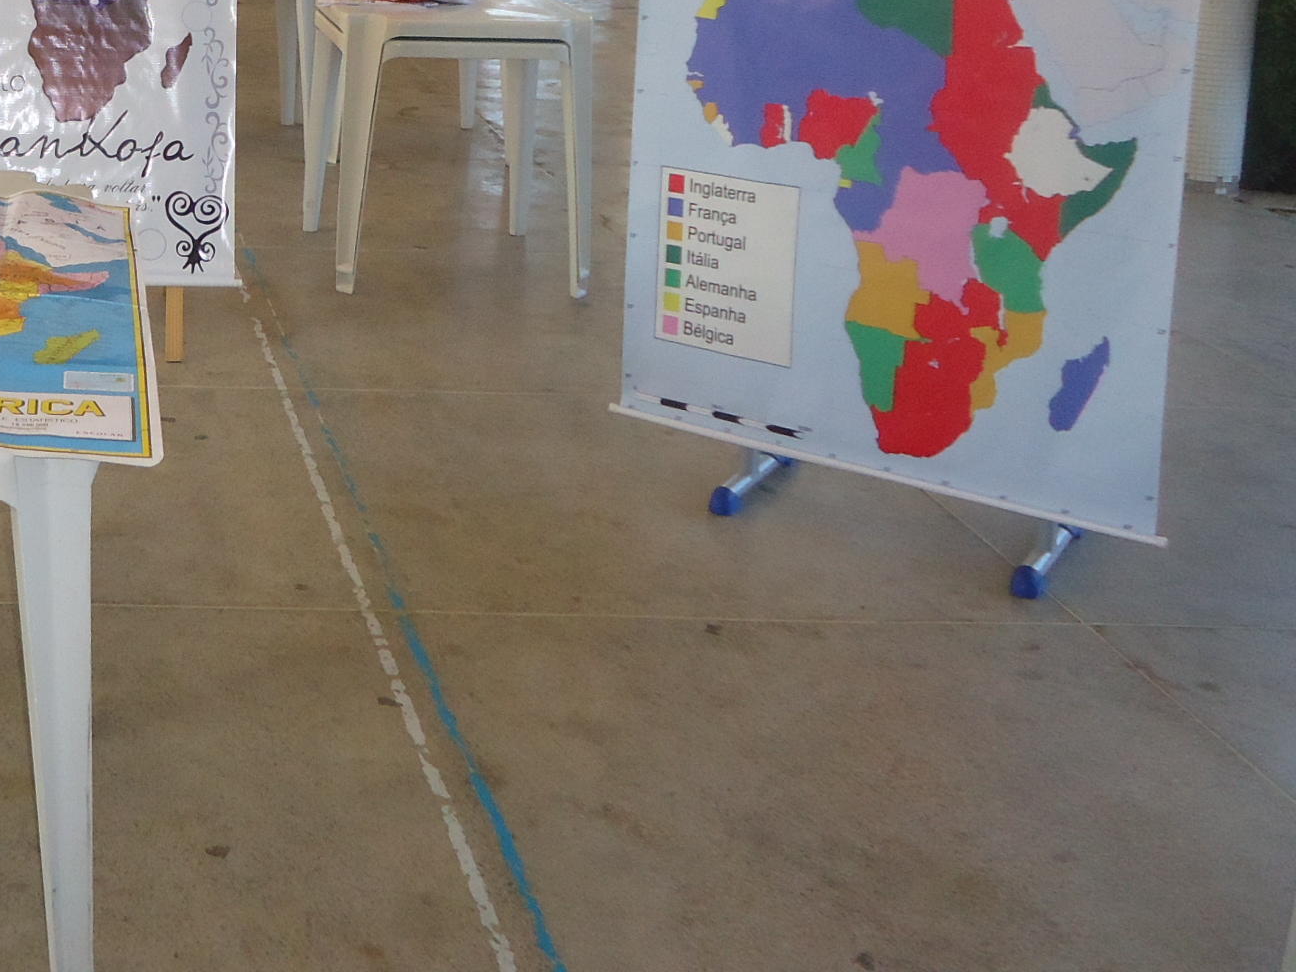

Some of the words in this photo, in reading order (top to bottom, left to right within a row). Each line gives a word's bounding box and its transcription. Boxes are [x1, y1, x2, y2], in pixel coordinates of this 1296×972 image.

[104, 179, 148, 193] voltar
[689, 178, 757, 204] Inglaterra
[688, 202, 737, 227] França
[687, 225, 747, 252] Portugal
[686, 250, 719, 270] Itália
[685, 274, 757, 302] Alemanha
[684, 297, 747, 324] Espanha
[683, 320, 734, 346] Bélgica
